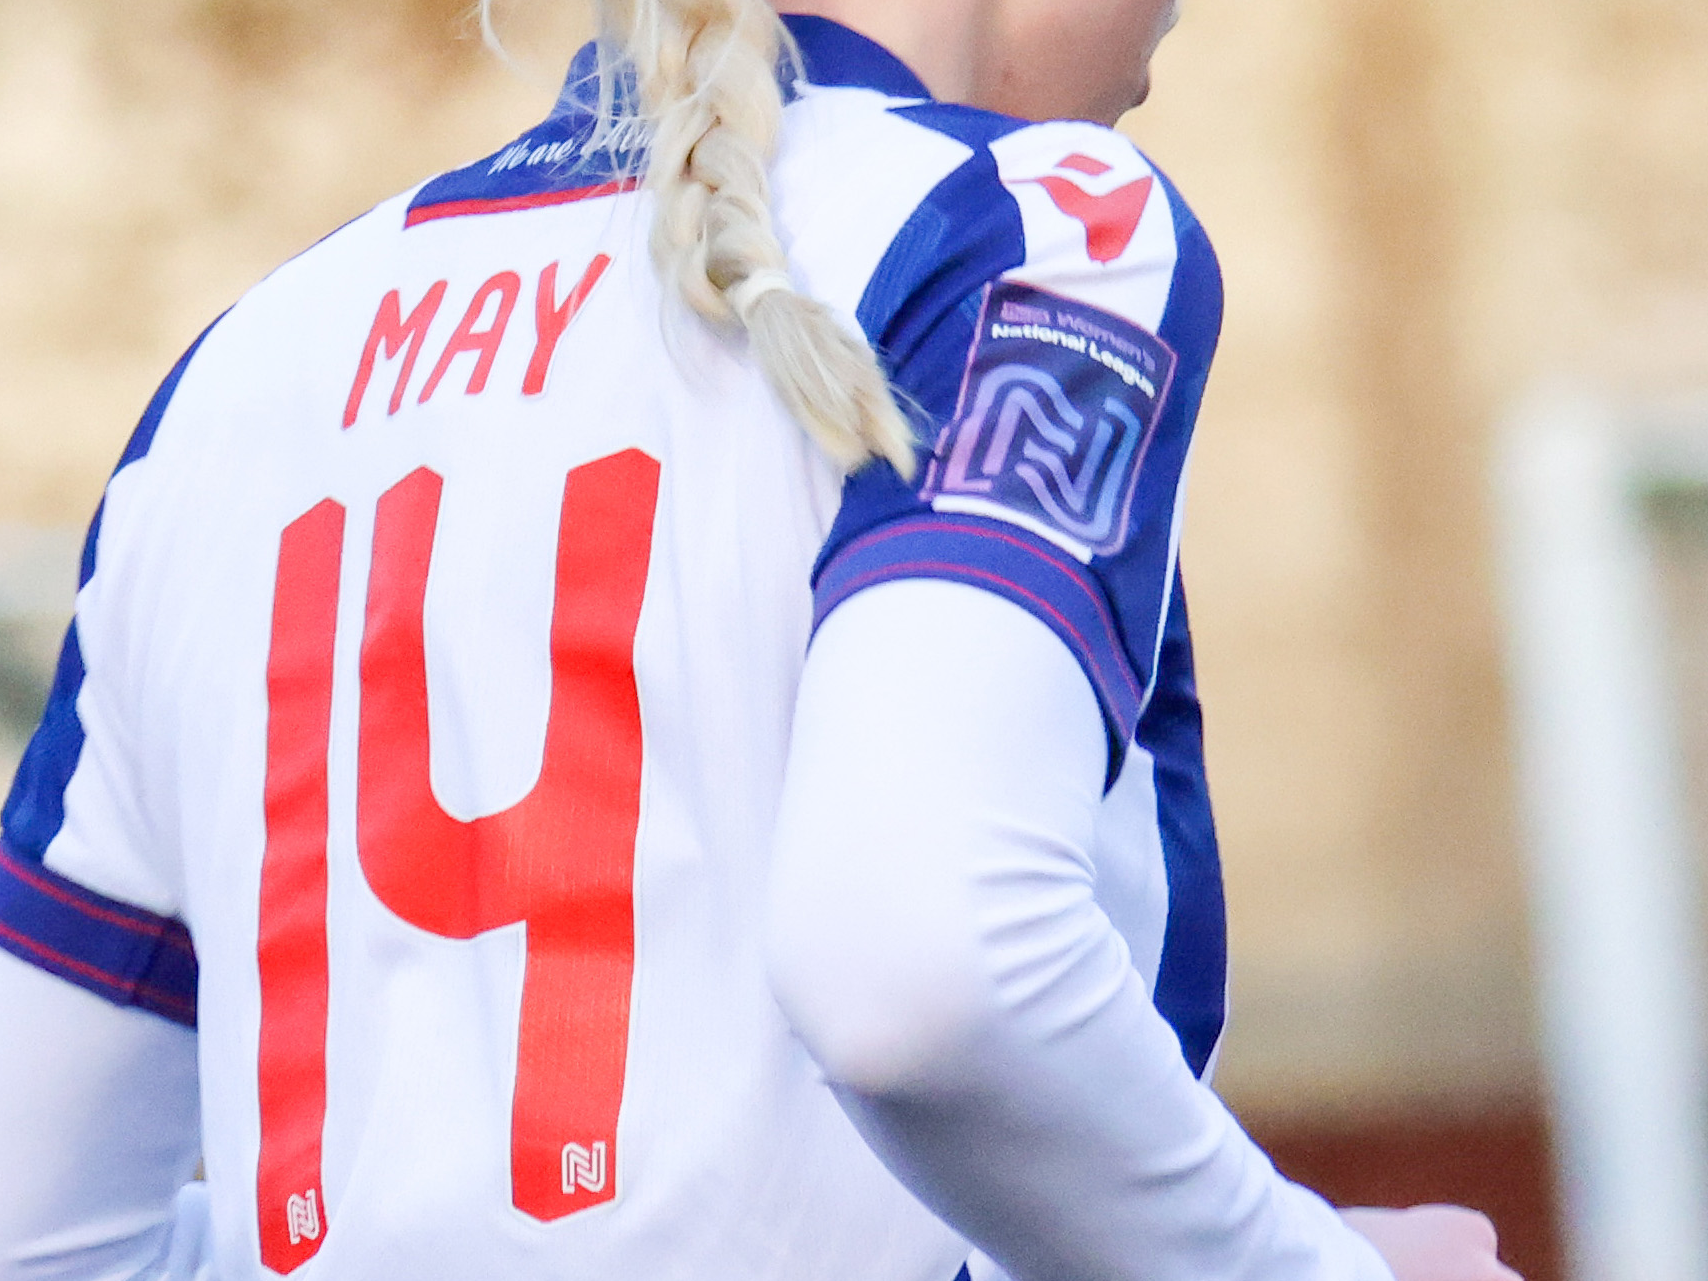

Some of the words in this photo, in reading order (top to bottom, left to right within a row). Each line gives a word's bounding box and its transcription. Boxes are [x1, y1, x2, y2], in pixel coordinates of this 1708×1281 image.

[525, 138, 575, 167] are
[342, 252, 611, 429] MAY
[991, 323, 1086, 354] National
[1089, 340, 1155, 399] League
[257, 445, 661, 1276] 14
